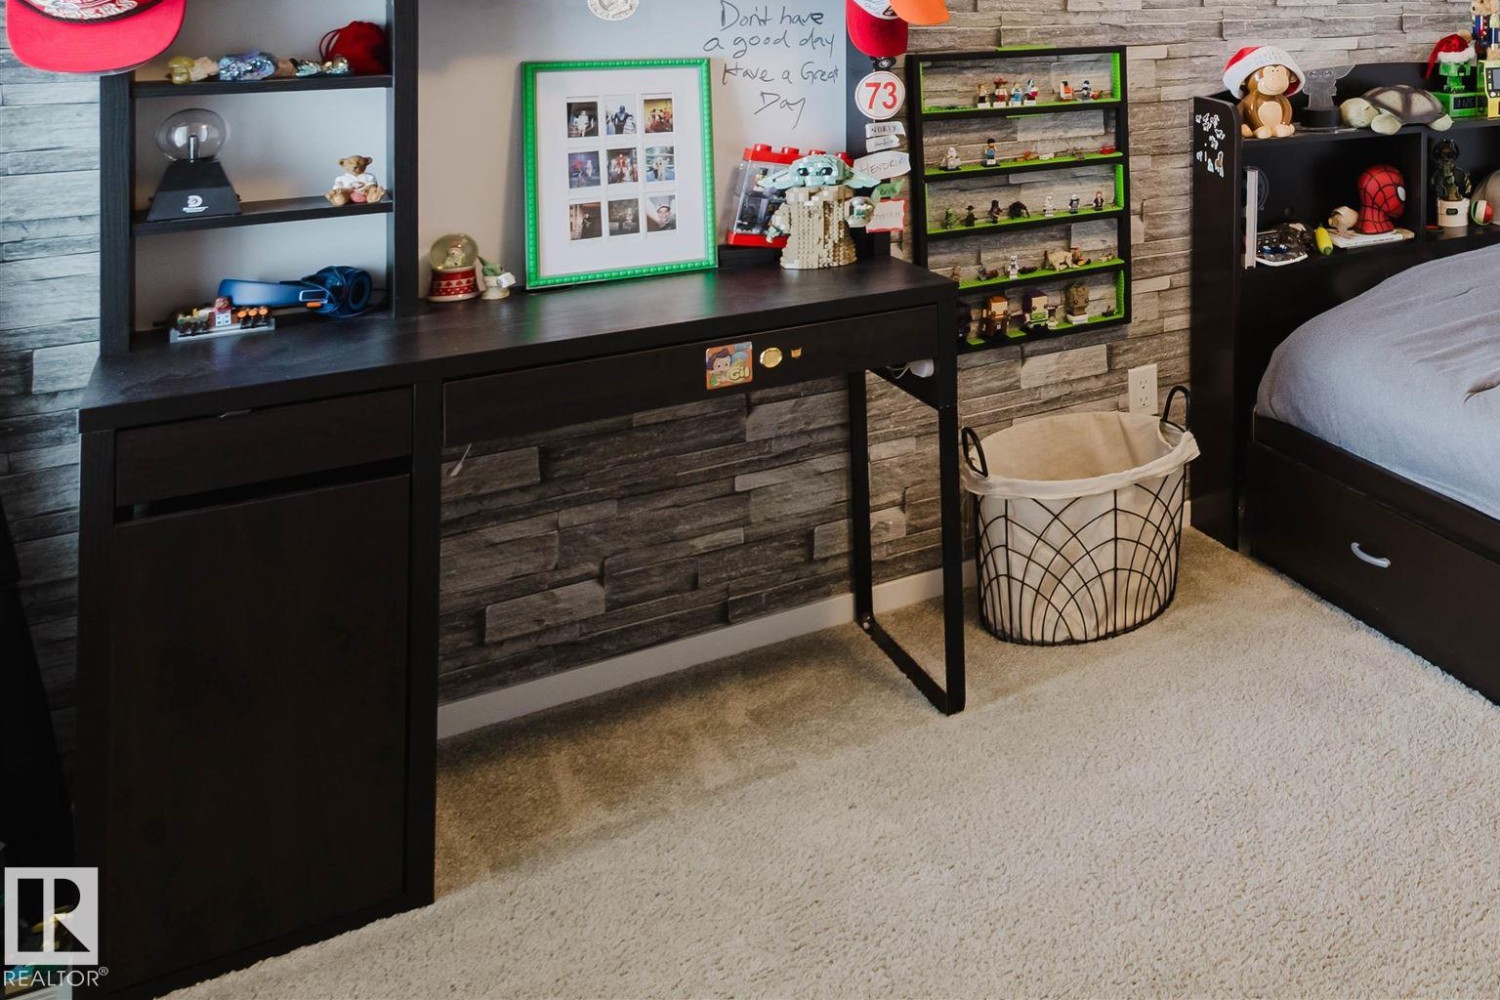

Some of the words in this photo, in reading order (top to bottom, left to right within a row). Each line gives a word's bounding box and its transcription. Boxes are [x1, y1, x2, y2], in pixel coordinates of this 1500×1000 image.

[720, 0, 772, 31] Don't
[779, 6, 824, 26] have
[703, 37, 724, 51] a
[732, 30, 790, 58] good
[799, 28, 835, 57] day
[722, 63, 774, 85] Have
[781, 70, 793, 84] a
[800, 61, 839, 85] Great
[754, 91, 806, 130] Day
[865, 82, 898, 110] 73
[729, 365, 750, 381] Gil
